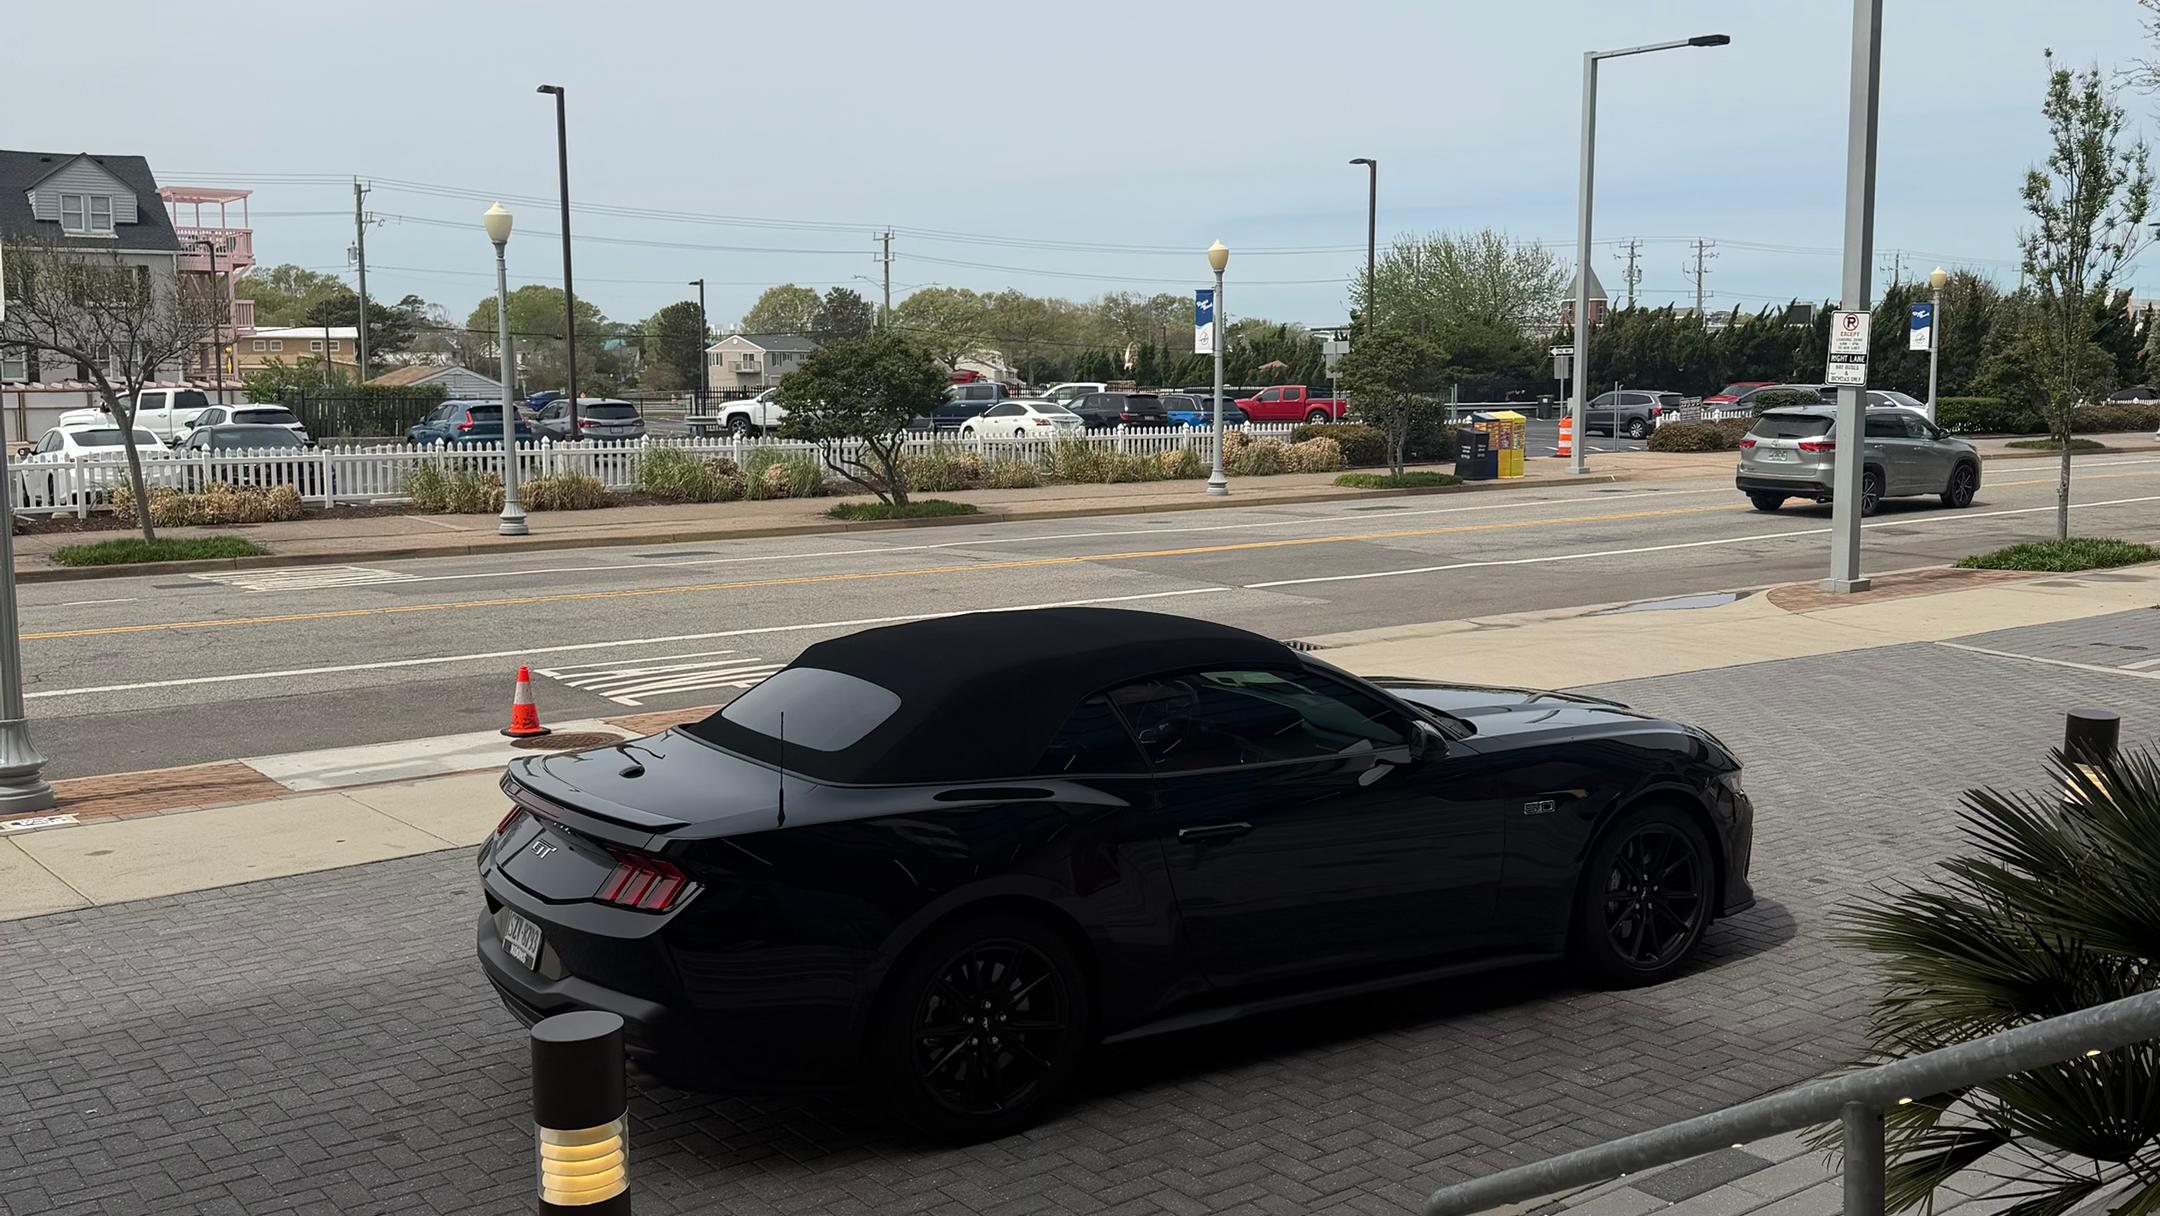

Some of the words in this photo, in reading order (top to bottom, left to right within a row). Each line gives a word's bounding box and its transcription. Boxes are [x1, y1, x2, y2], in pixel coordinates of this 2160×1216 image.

[1830, 354, 1848, 362] RIGHT
[1849, 355, 1866, 363] LANE
[531, 839, 558, 858] GT
